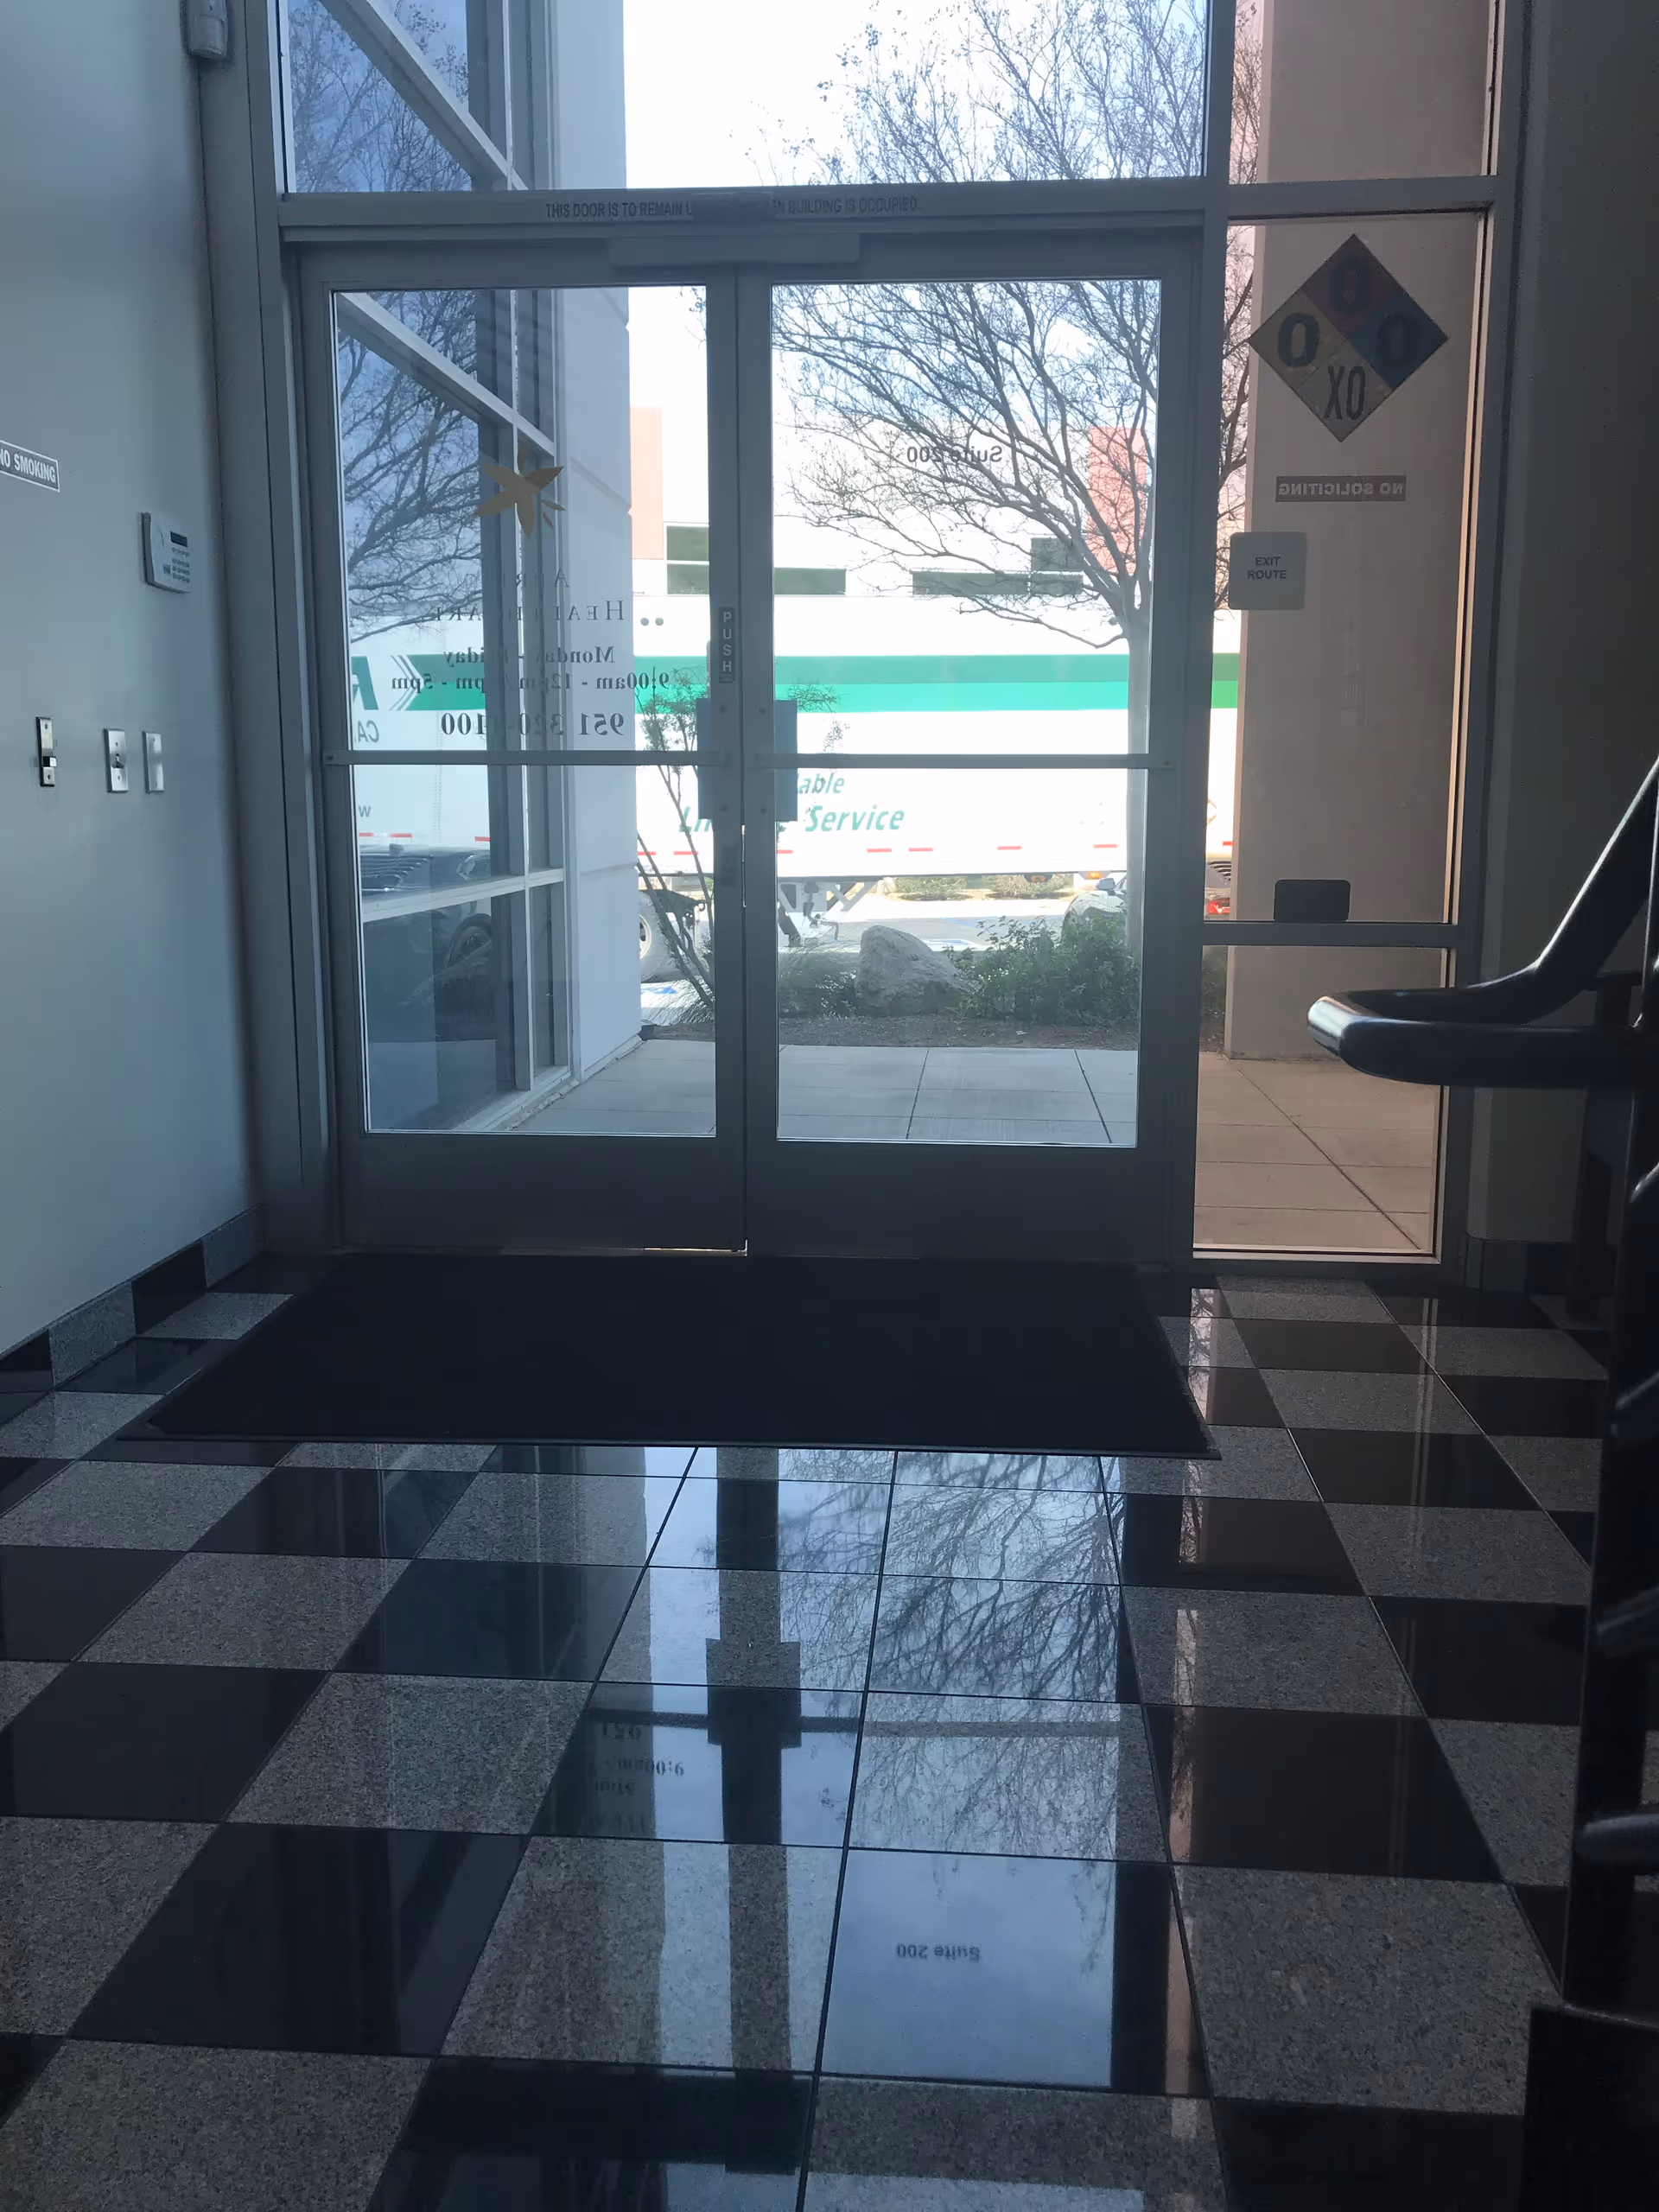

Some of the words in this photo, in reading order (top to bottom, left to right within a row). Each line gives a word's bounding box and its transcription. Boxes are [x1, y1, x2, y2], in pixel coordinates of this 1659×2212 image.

[546, 202, 570, 219] THIS
[573, 201, 606, 218] DOOR
[608, 200, 619, 217] IS
[621, 200, 637, 217] TO
[639, 200, 683, 217] REMAIN
[788, 198, 842, 214] BUILDING
[844, 196, 855, 213] IS
[14, 452, 56, 483] SMOKING
[1255, 556, 1281, 567] EXIT
[1247, 569, 1287, 581] ROUTE
[722, 611, 733, 672] PUSH
[804, 804, 905, 832] Service
[896, 1943, 929, 1960] 200
